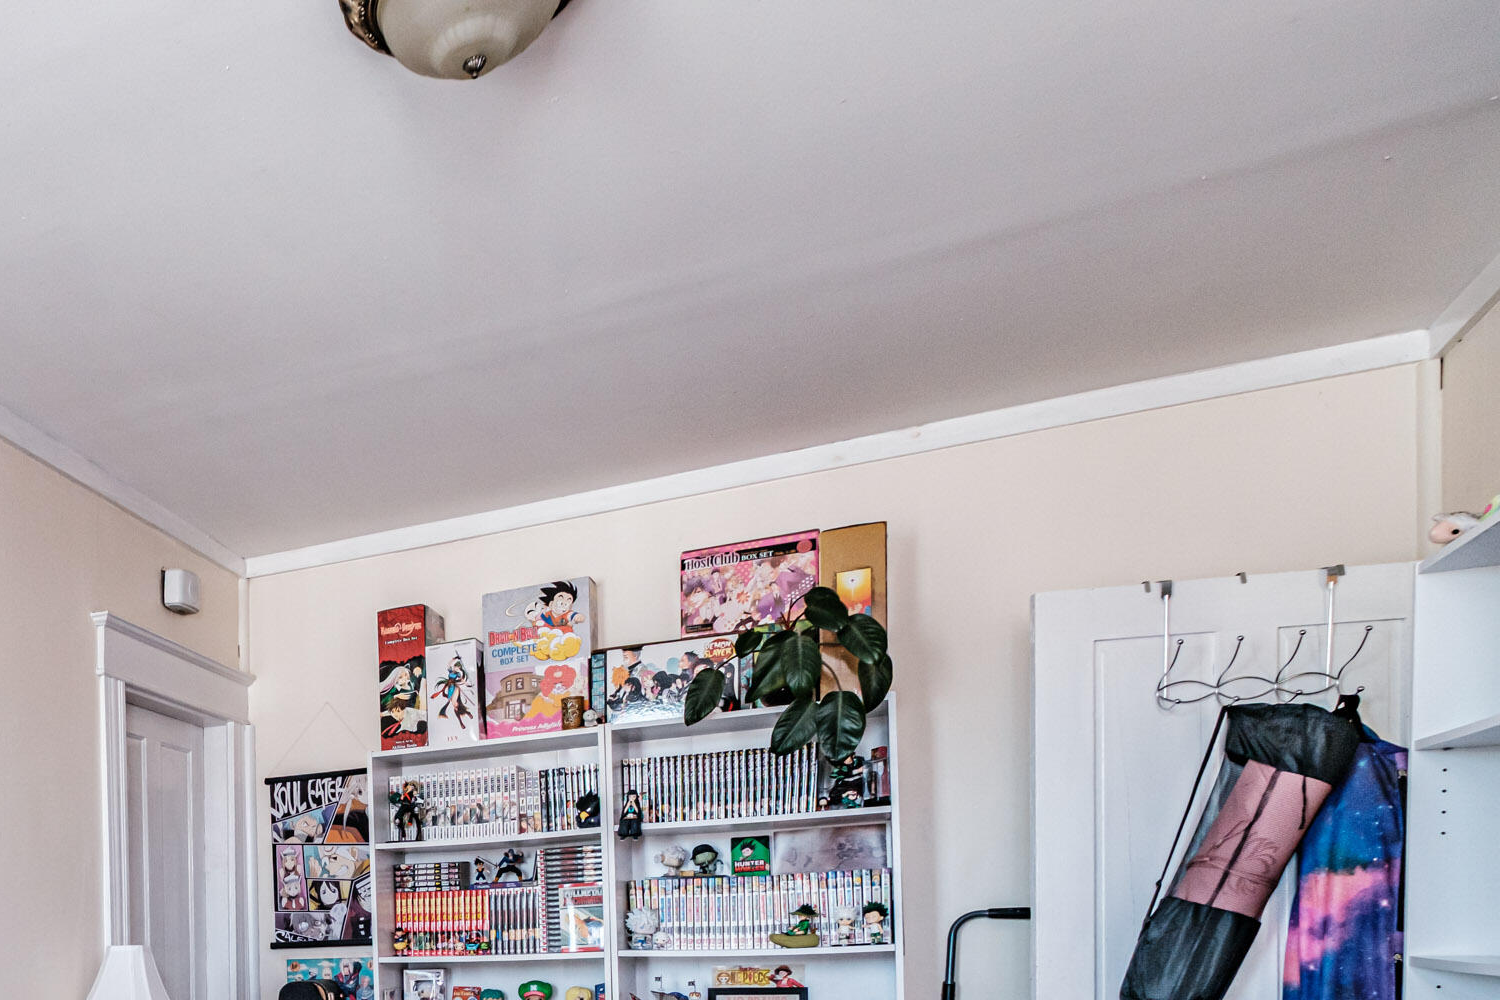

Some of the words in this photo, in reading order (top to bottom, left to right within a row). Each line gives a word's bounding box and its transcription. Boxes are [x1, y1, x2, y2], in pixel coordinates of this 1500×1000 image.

[685, 554, 713, 570] Host
[713, 551, 740, 567] Club
[741, 552, 759, 561] BOX
[759, 550, 775, 560] SET
[492, 642, 537, 658] COMPLETE
[703, 640, 733, 651] DEMON
[703, 648, 734, 658] SLAYER
[500, 656, 514, 665] BOX
[516, 654, 529, 664] SET
[271, 780, 307, 819] SOUL
[307, 776, 343, 809] EATER
[734, 860, 765, 868] HUNTER
